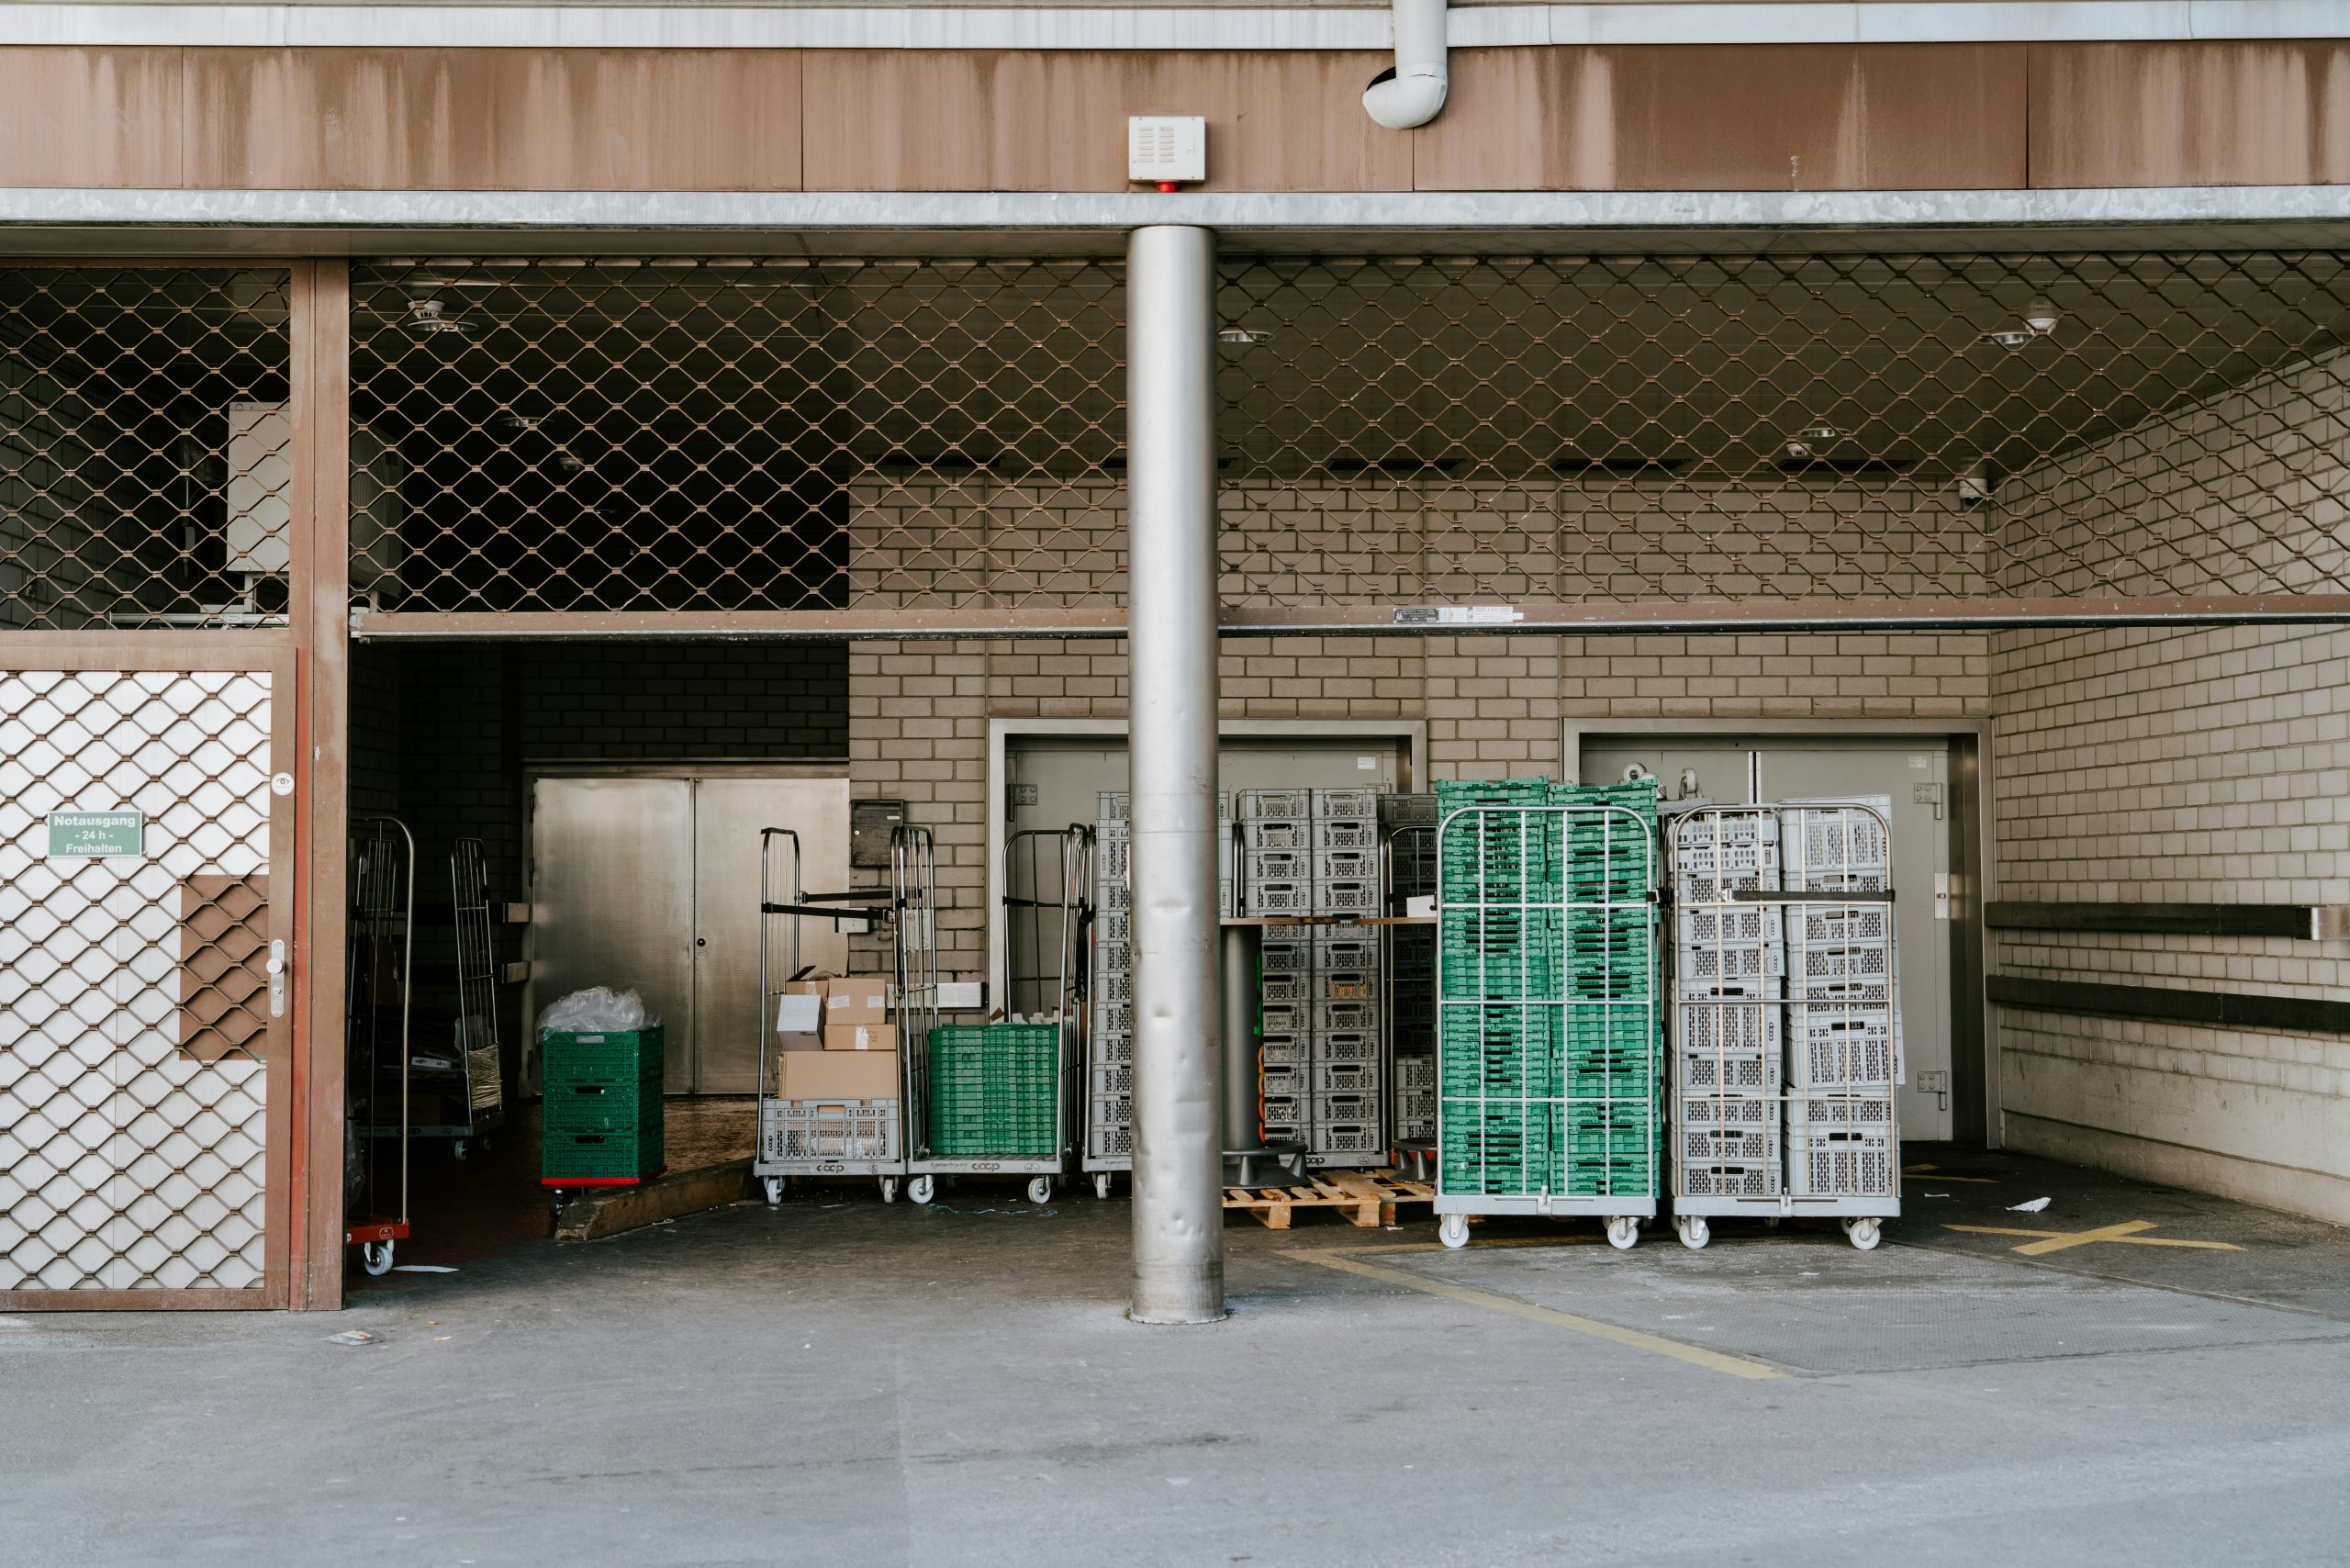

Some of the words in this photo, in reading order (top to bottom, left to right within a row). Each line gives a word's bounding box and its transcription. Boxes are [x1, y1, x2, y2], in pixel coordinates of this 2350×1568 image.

[54, 816, 136, 827] Notausgang
[82, 831, 96, 840] 24
[98, 831, 106, 840] h
[65, 844, 122, 854] Freihalten
[1306, 1157, 1325, 1166] oop
[816, 1164, 845, 1174] coop
[971, 1162, 1001, 1171] coop
